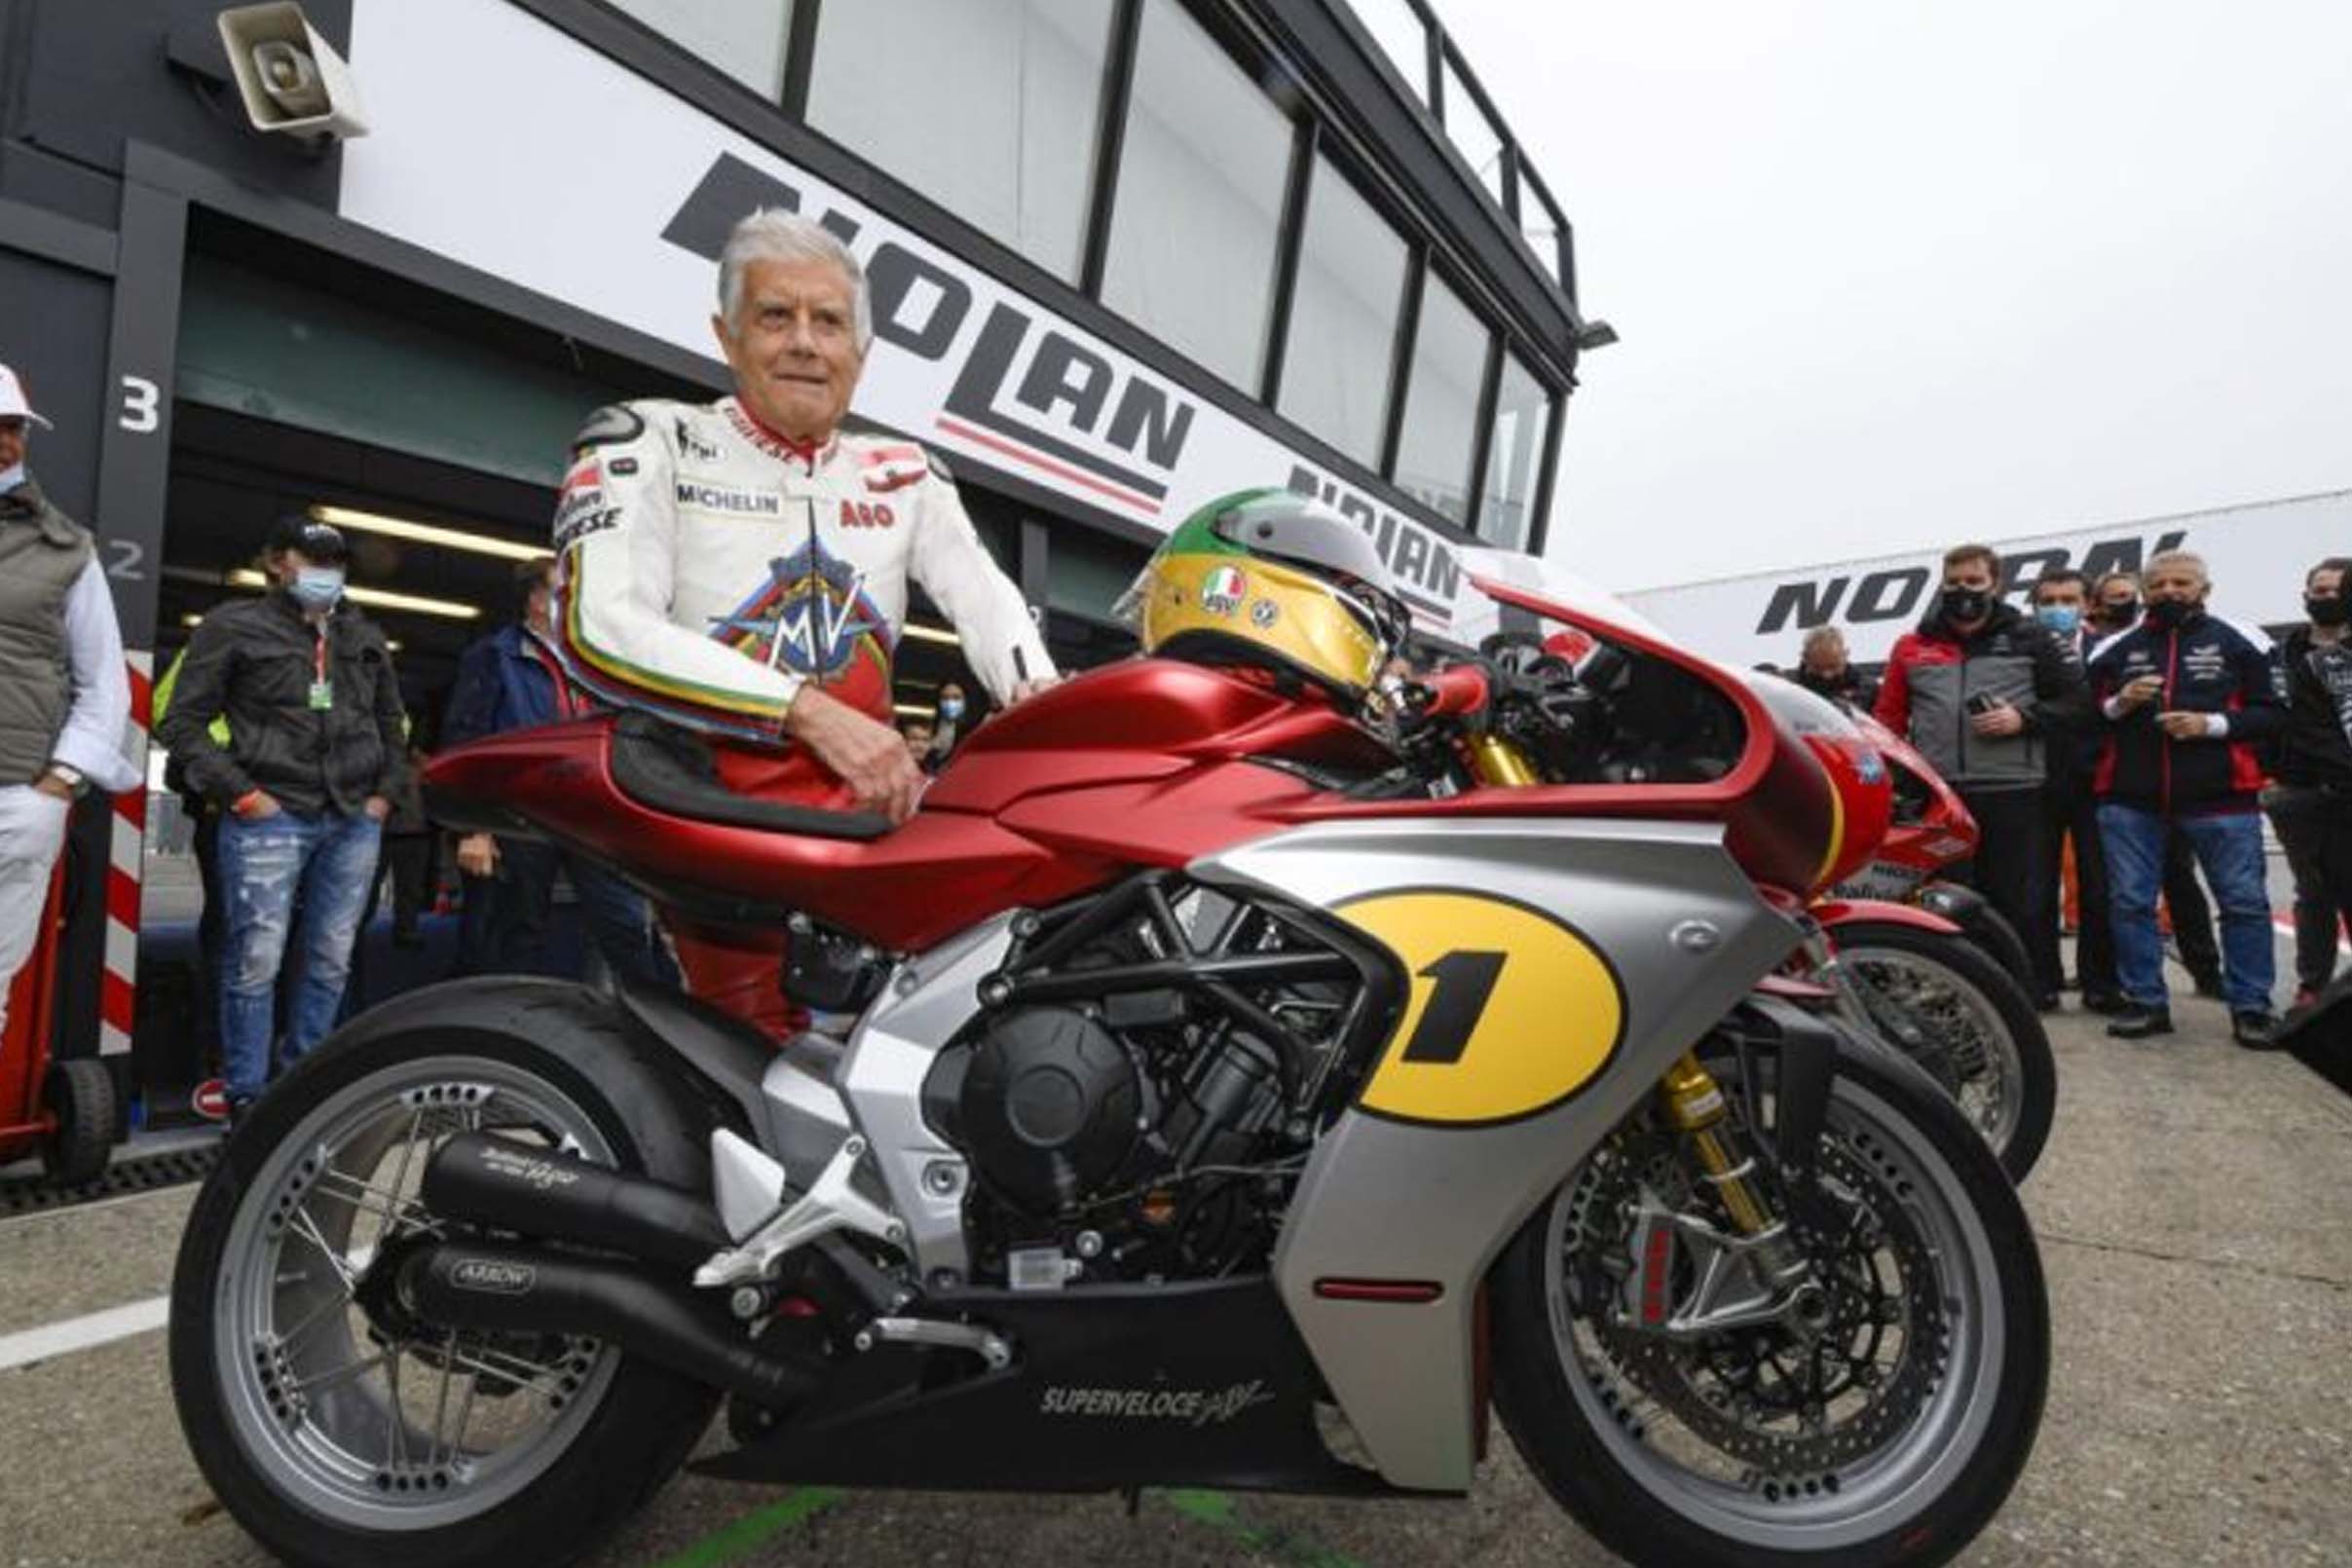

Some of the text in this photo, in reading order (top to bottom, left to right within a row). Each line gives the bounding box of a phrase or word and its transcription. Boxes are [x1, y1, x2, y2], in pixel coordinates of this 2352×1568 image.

[119, 374, 160, 432] 3
[677, 485, 779, 514] MICHELIN
[107, 539, 144, 579] 2
[1400, 951, 1509, 1064] 1
[1040, 1387, 1204, 1417] SUPERVELOCE
